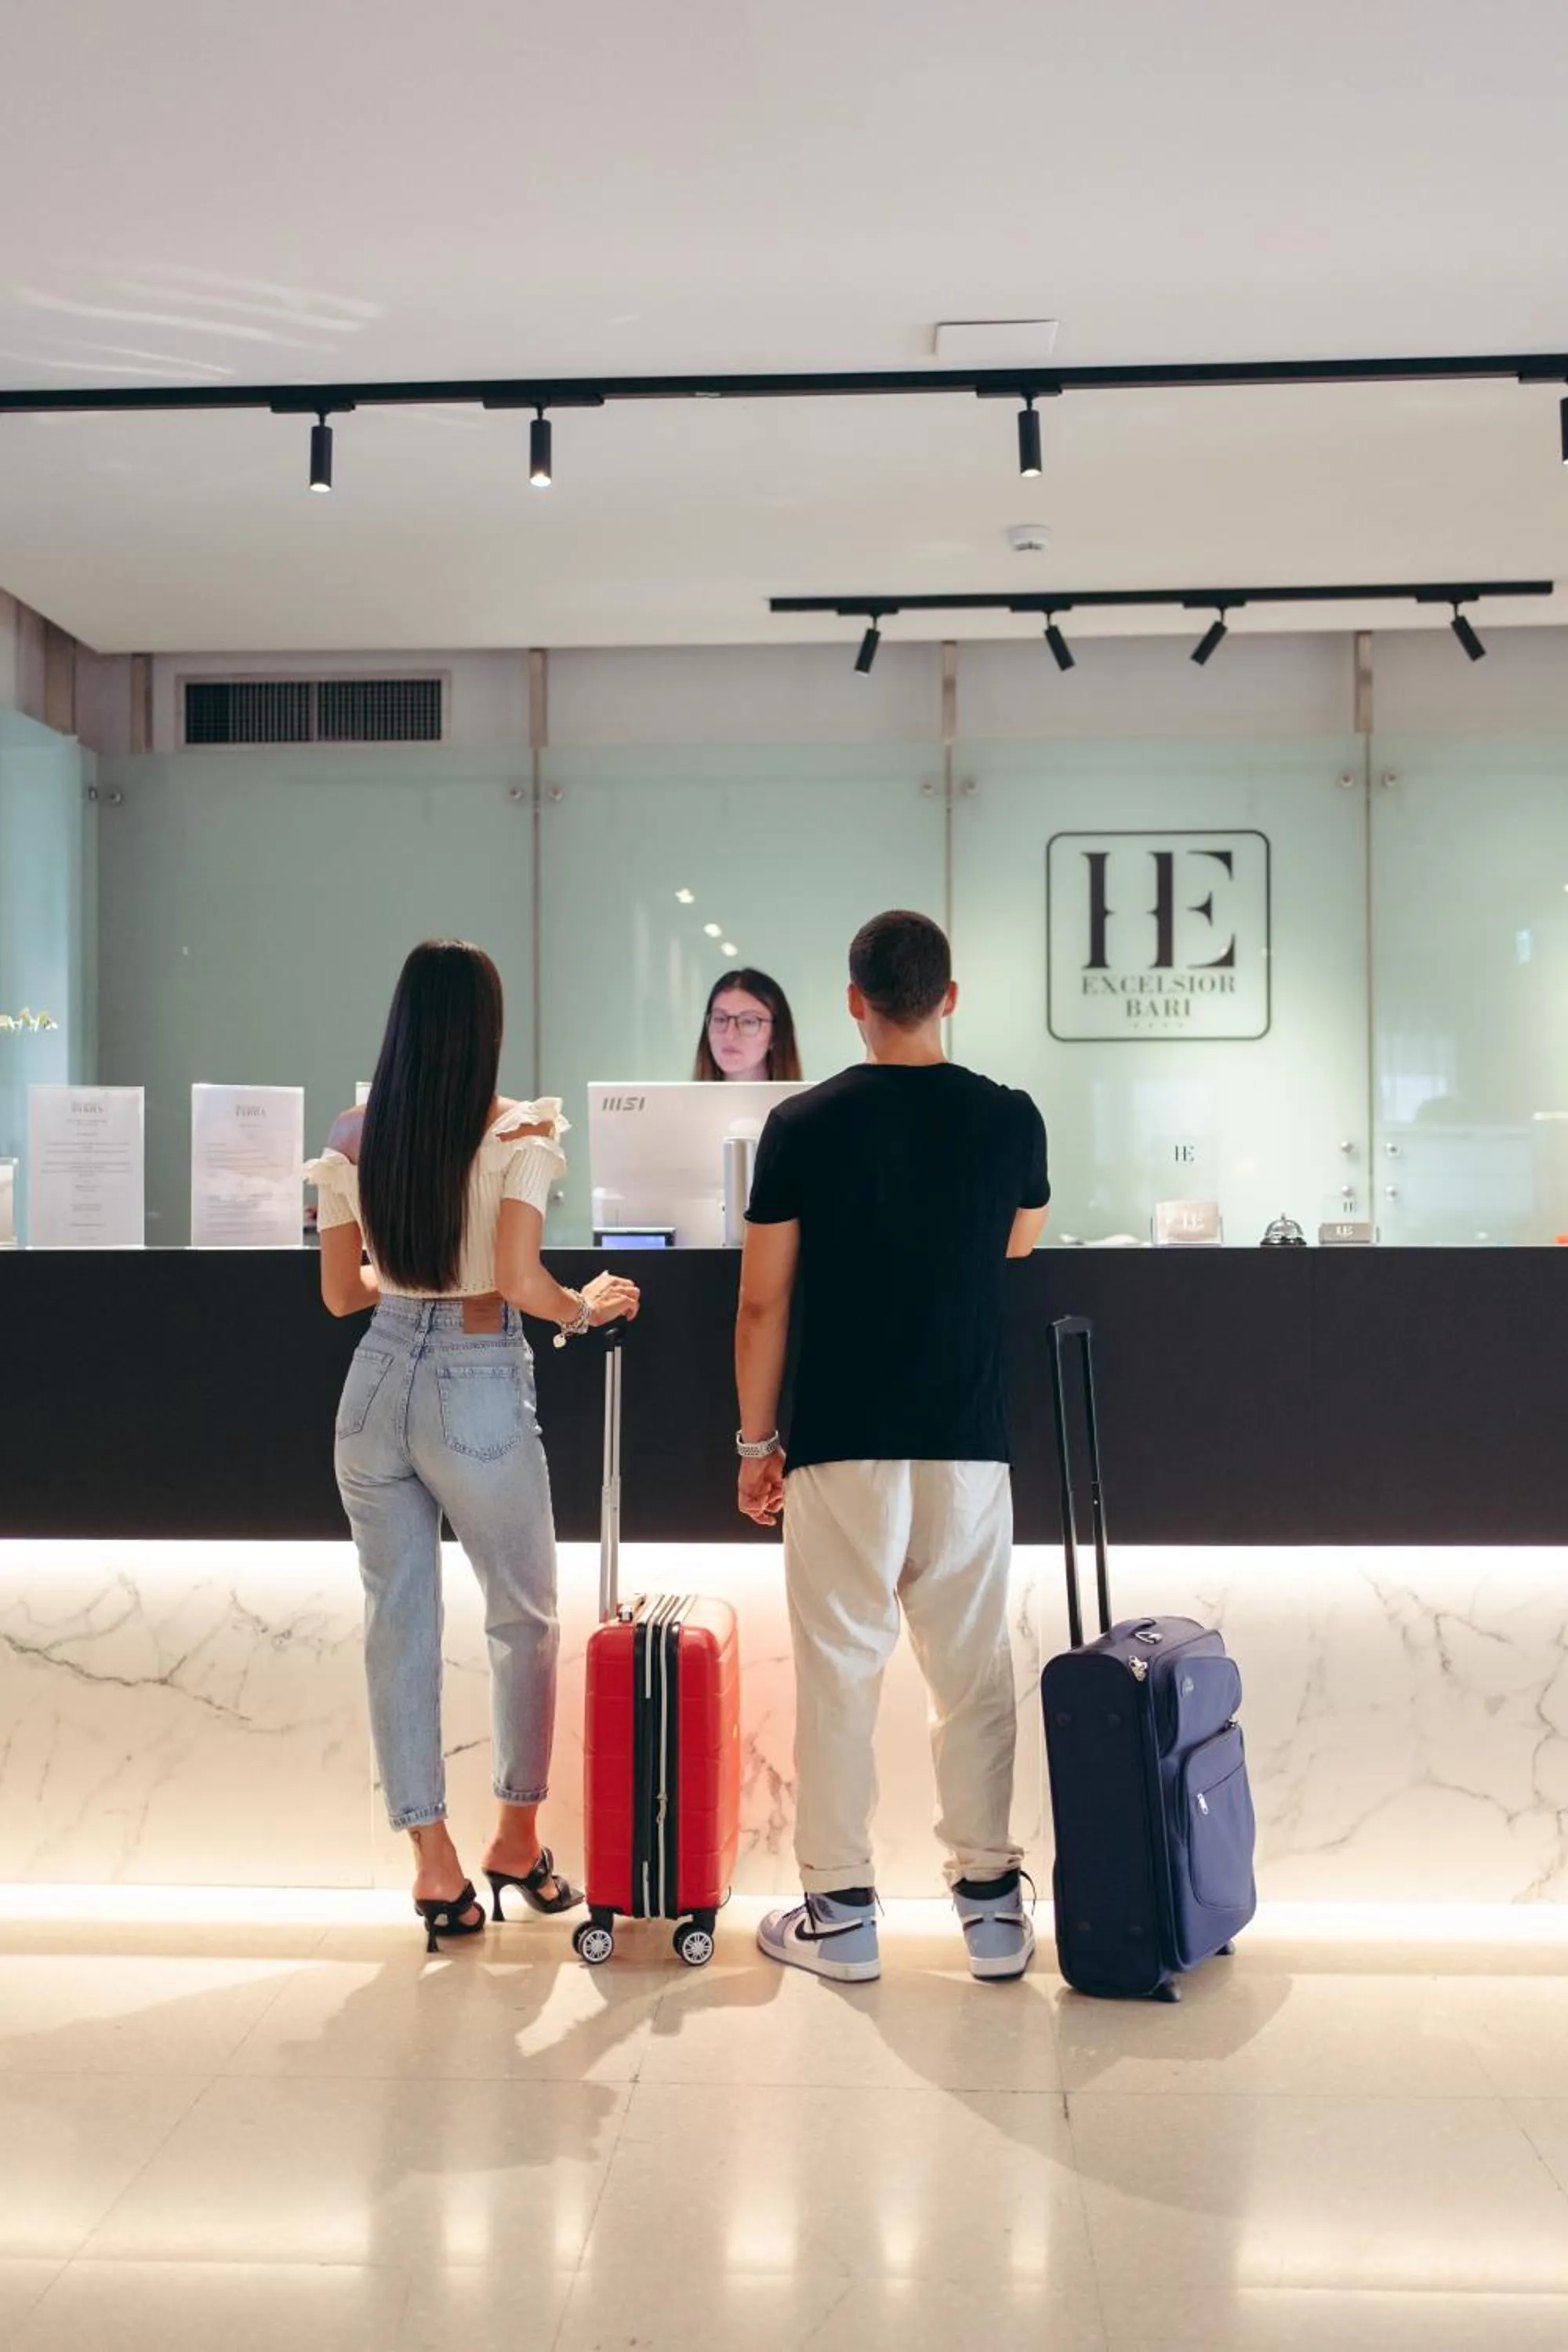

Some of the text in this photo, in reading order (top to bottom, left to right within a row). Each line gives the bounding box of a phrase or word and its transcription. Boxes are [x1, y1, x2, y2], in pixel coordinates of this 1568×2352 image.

[1082, 975, 1236, 996] EXCELSIOR
[1126, 998, 1190, 1018] BARI
[602, 1097, 645, 1111] MSI
